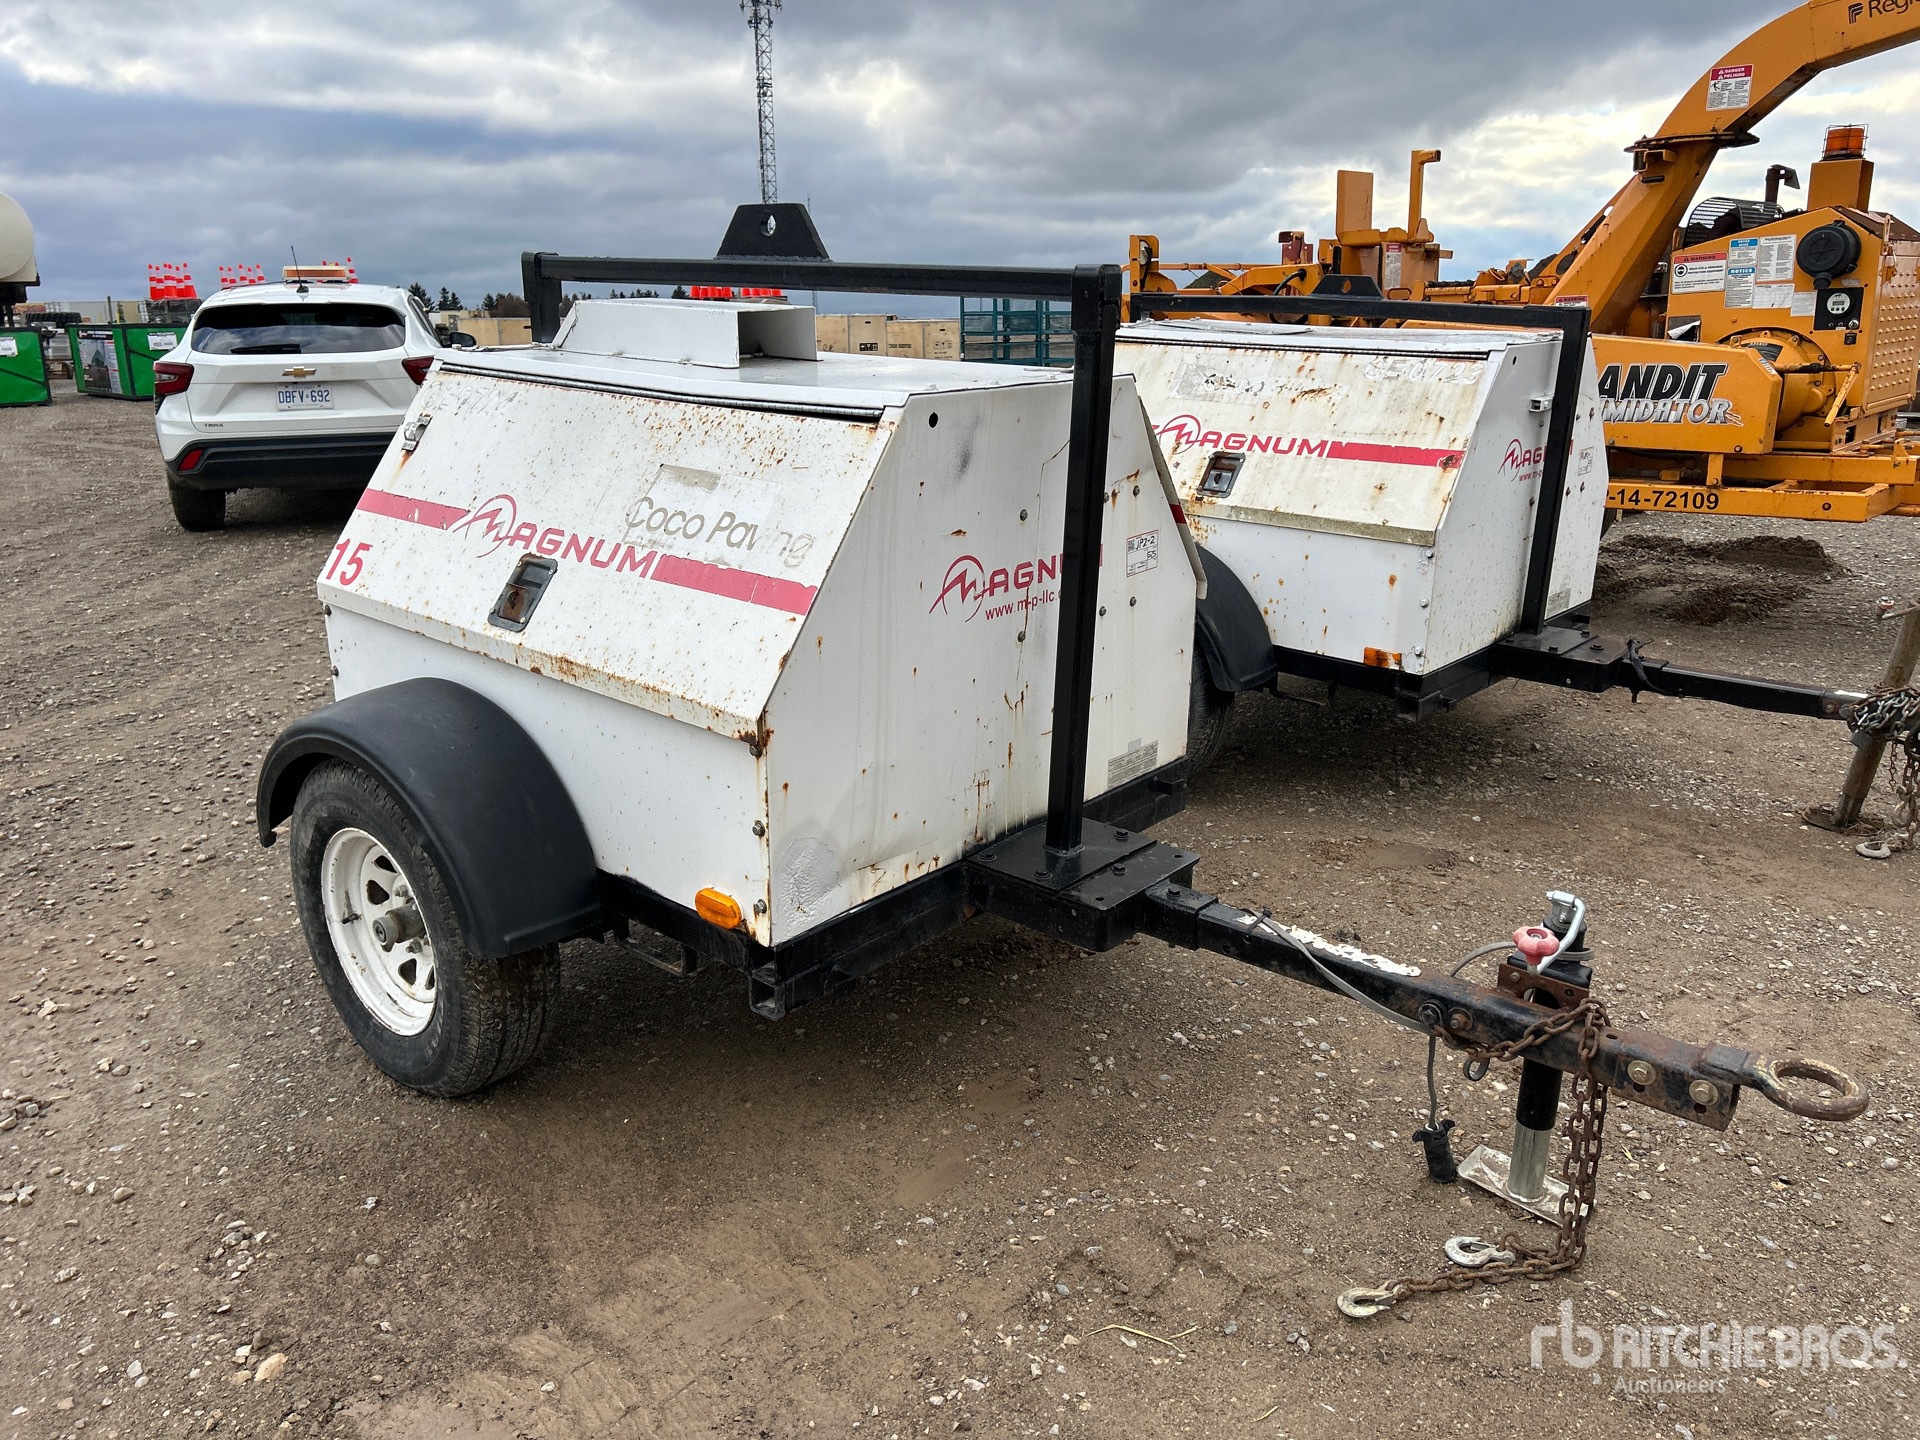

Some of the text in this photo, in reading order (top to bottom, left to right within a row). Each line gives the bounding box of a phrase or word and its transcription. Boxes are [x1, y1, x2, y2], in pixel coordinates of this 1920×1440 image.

[278, 389, 331, 404] DBFV 692
[1598, 363, 1730, 401] ANDIT
[1156, 414, 1329, 458] MAGNUM
[624, 496, 705, 540] Coco
[1606, 488, 1719, 511] -14-72109
[453, 494, 658, 579] MAGNUM
[325, 538, 373, 586] 15
[985, 589, 1061, 621] www.m-p-llc.
